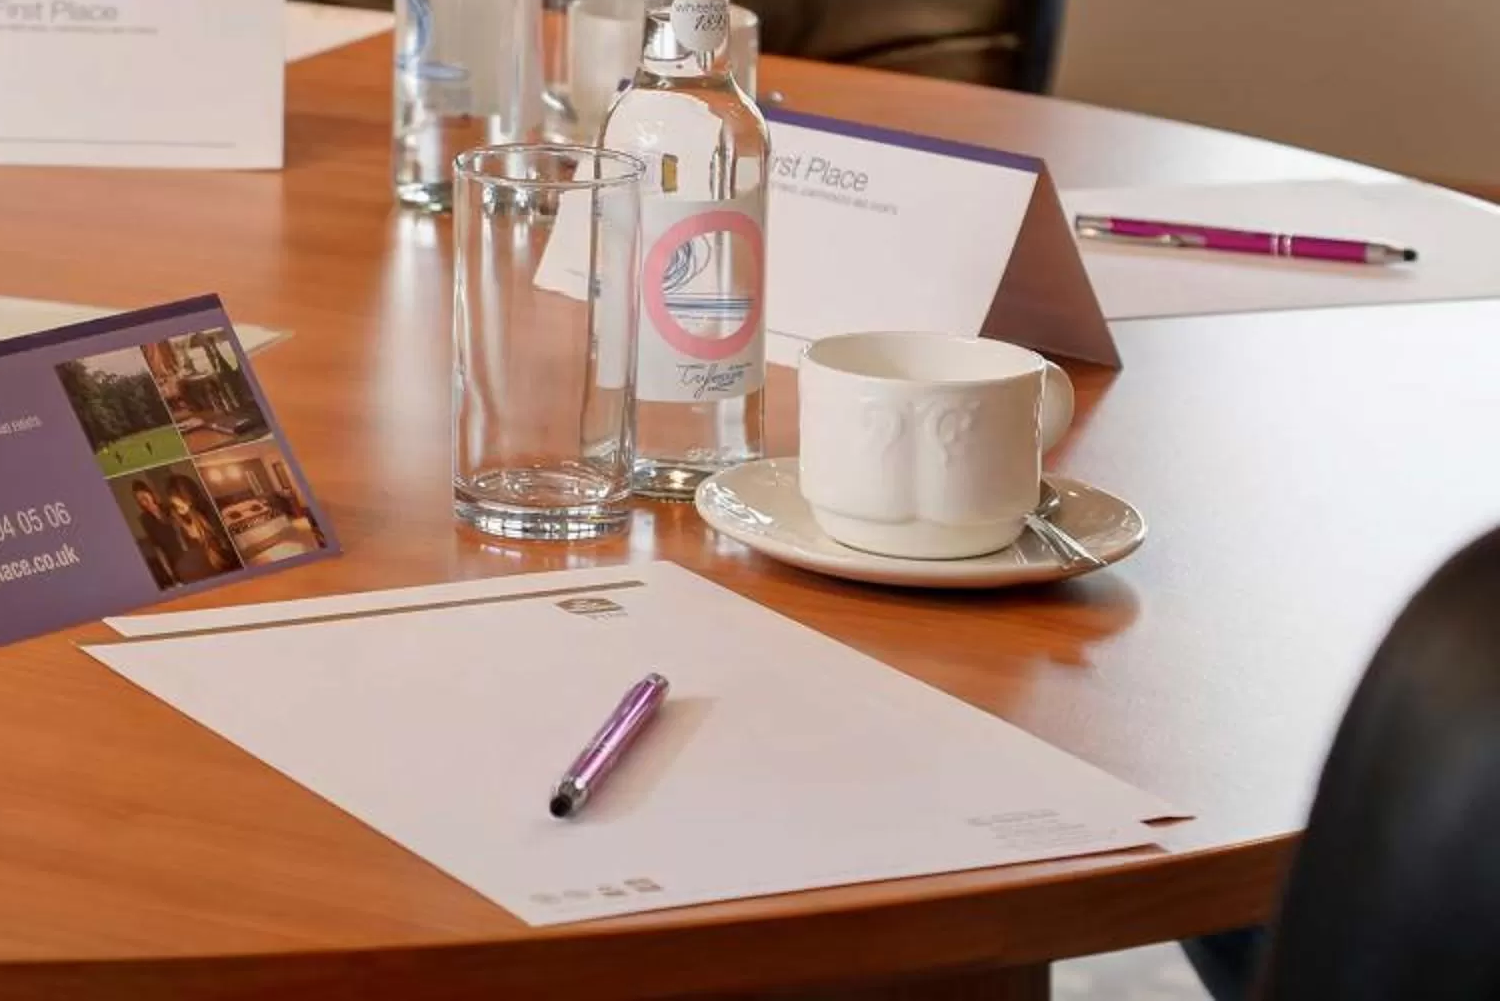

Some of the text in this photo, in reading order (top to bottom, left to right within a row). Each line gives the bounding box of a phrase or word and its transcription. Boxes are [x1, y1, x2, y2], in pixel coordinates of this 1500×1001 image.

[773, 155, 869, 192] rst Place
[17, 508, 43, 535] 05
[43, 502, 72, 528] 06
